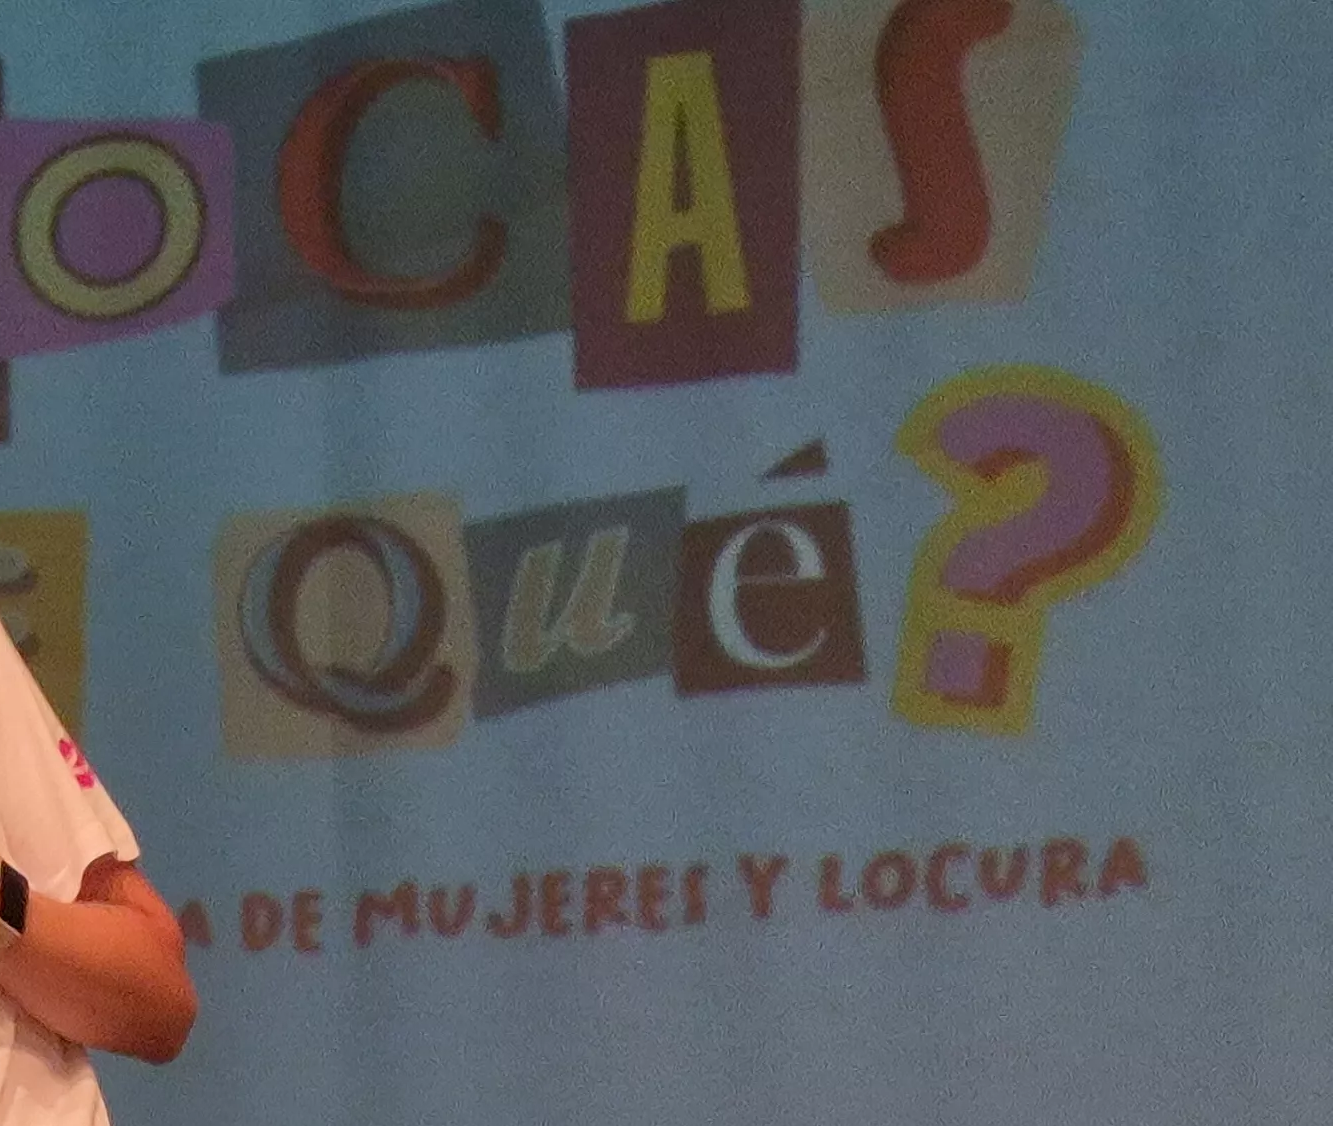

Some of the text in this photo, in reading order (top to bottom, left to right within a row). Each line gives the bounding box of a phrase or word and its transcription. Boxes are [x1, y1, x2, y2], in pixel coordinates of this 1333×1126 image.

[239, 889, 324, 952] DE
[352, 861, 709, 949] MUJERES
[738, 852, 788, 919] Y
[817, 836, 1148, 913] LOCURA
